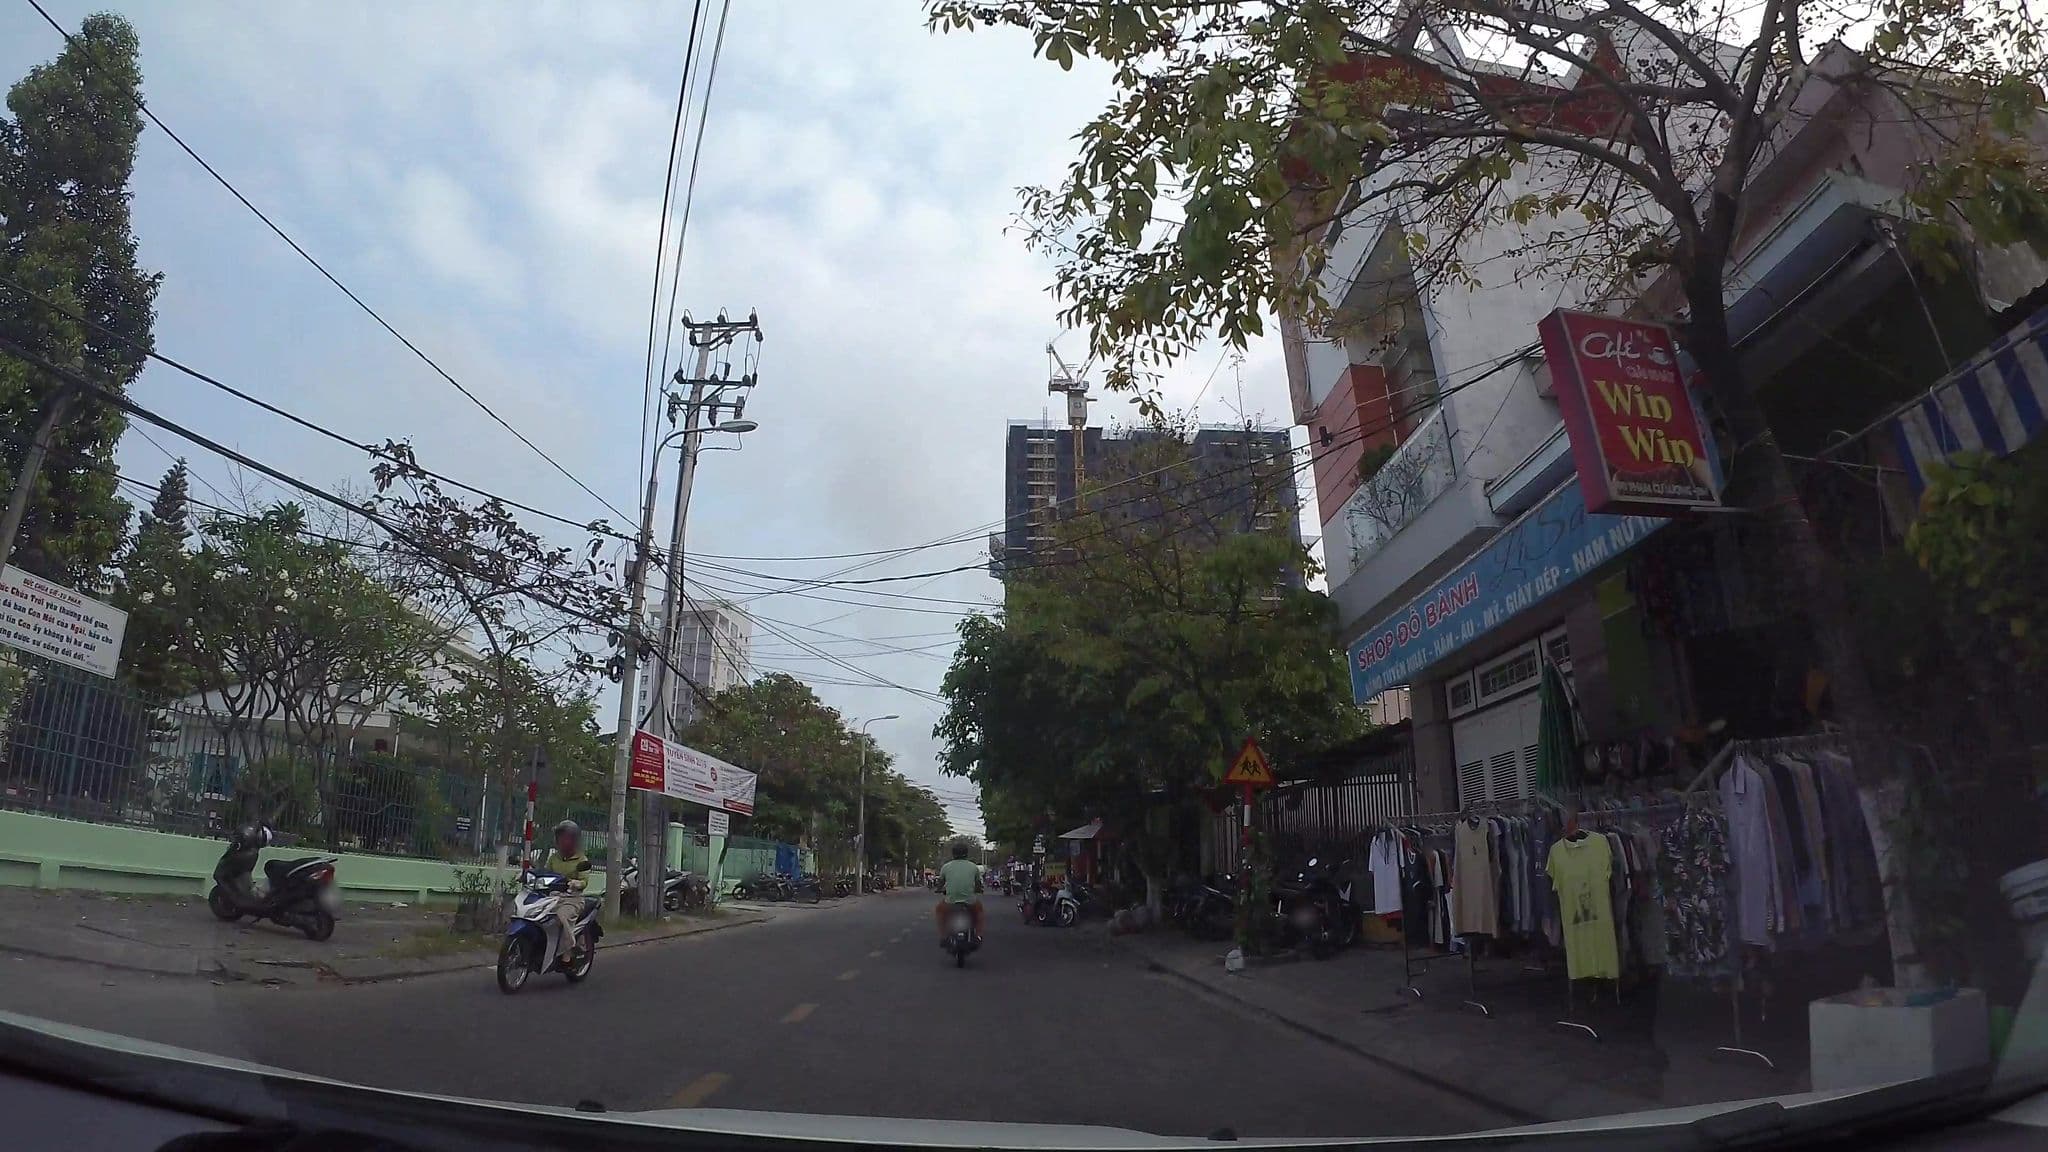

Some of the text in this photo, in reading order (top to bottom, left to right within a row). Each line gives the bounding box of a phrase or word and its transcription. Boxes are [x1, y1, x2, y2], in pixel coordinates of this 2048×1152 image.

[1593, 380, 1673, 423] Win
[1617, 425, 1695, 468] Win
[1572, 535, 1608, 573] NAM
[18, 618, 31, 630] Con
[27, 607, 41, 619] Con
[1358, 630, 1394, 672] SHOP
[1397, 606, 1422, 647] ĐỒ
